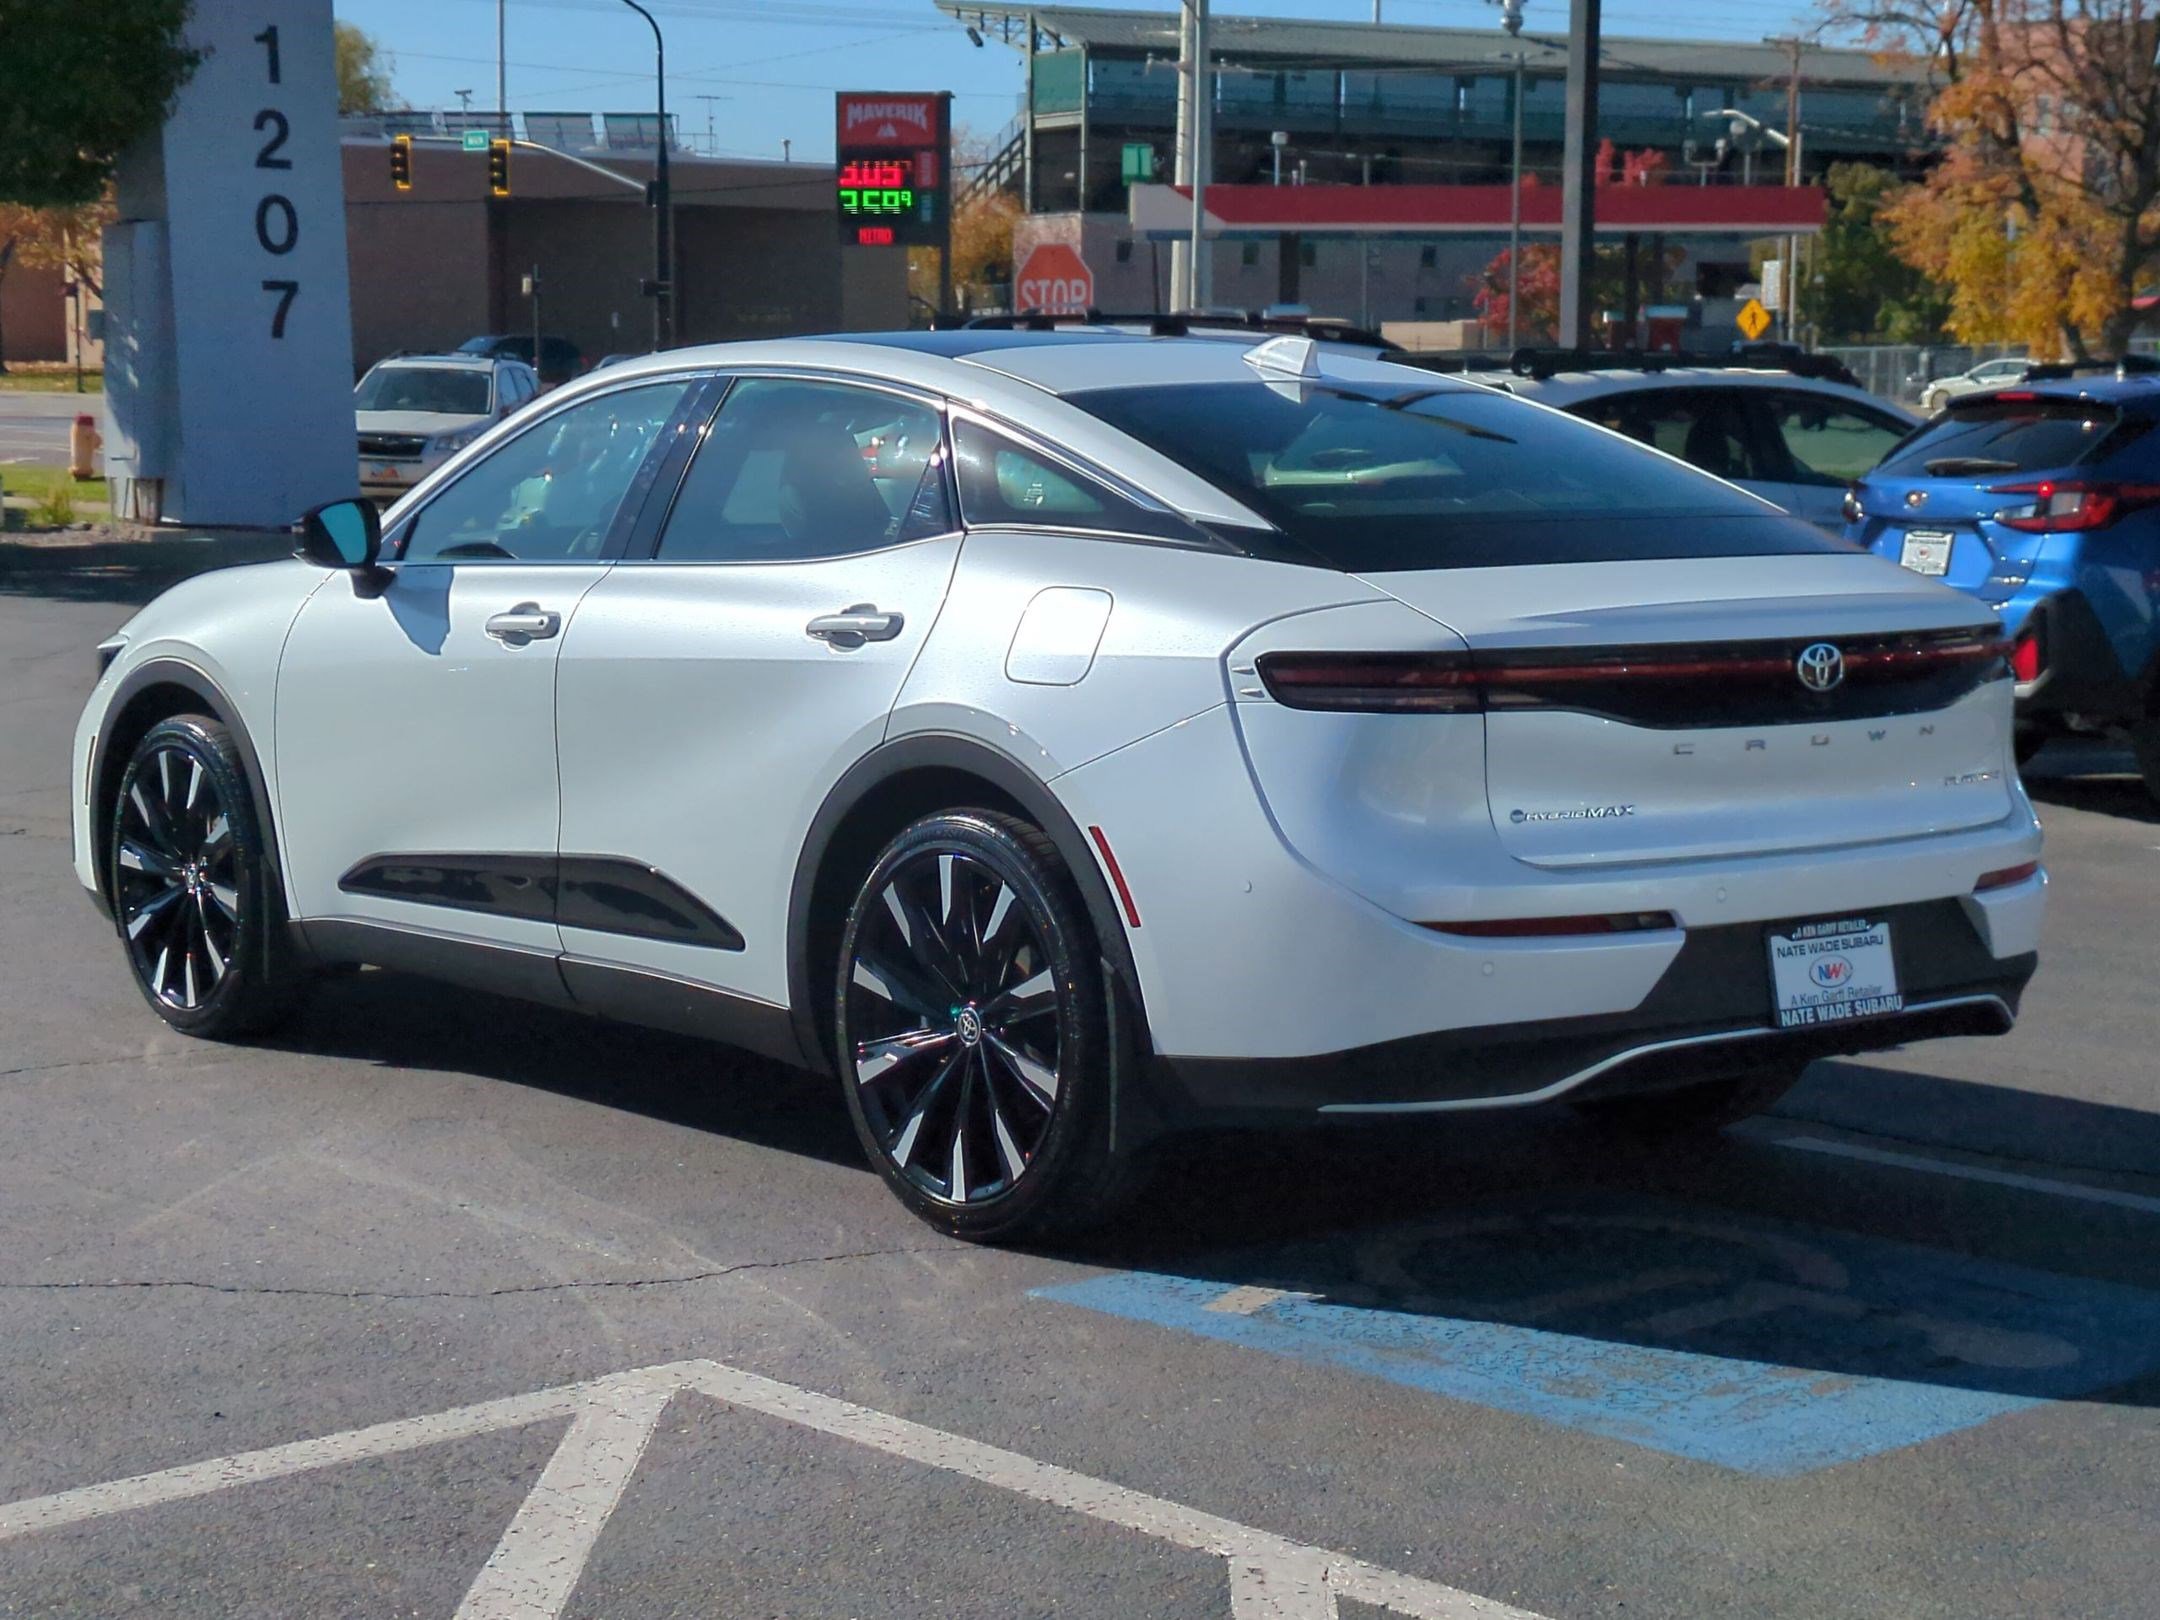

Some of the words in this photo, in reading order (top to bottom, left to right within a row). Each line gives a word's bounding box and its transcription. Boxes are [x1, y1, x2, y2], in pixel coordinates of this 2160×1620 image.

[846, 101, 929, 133] MAVERIK
[253, 24, 299, 340] 1207
[1021, 278, 1087, 315] STOP
[1672, 723, 1936, 756] CROWN
[1776, 943, 1807, 959] NATE
[1807, 939, 1840, 955] WADE
[1841, 934, 1884, 950] SUBARU
[1781, 1008, 1815, 1027] NATE
[1817, 1002, 1853, 1022] WADE
[1855, 995, 1902, 1016] SUBARU
